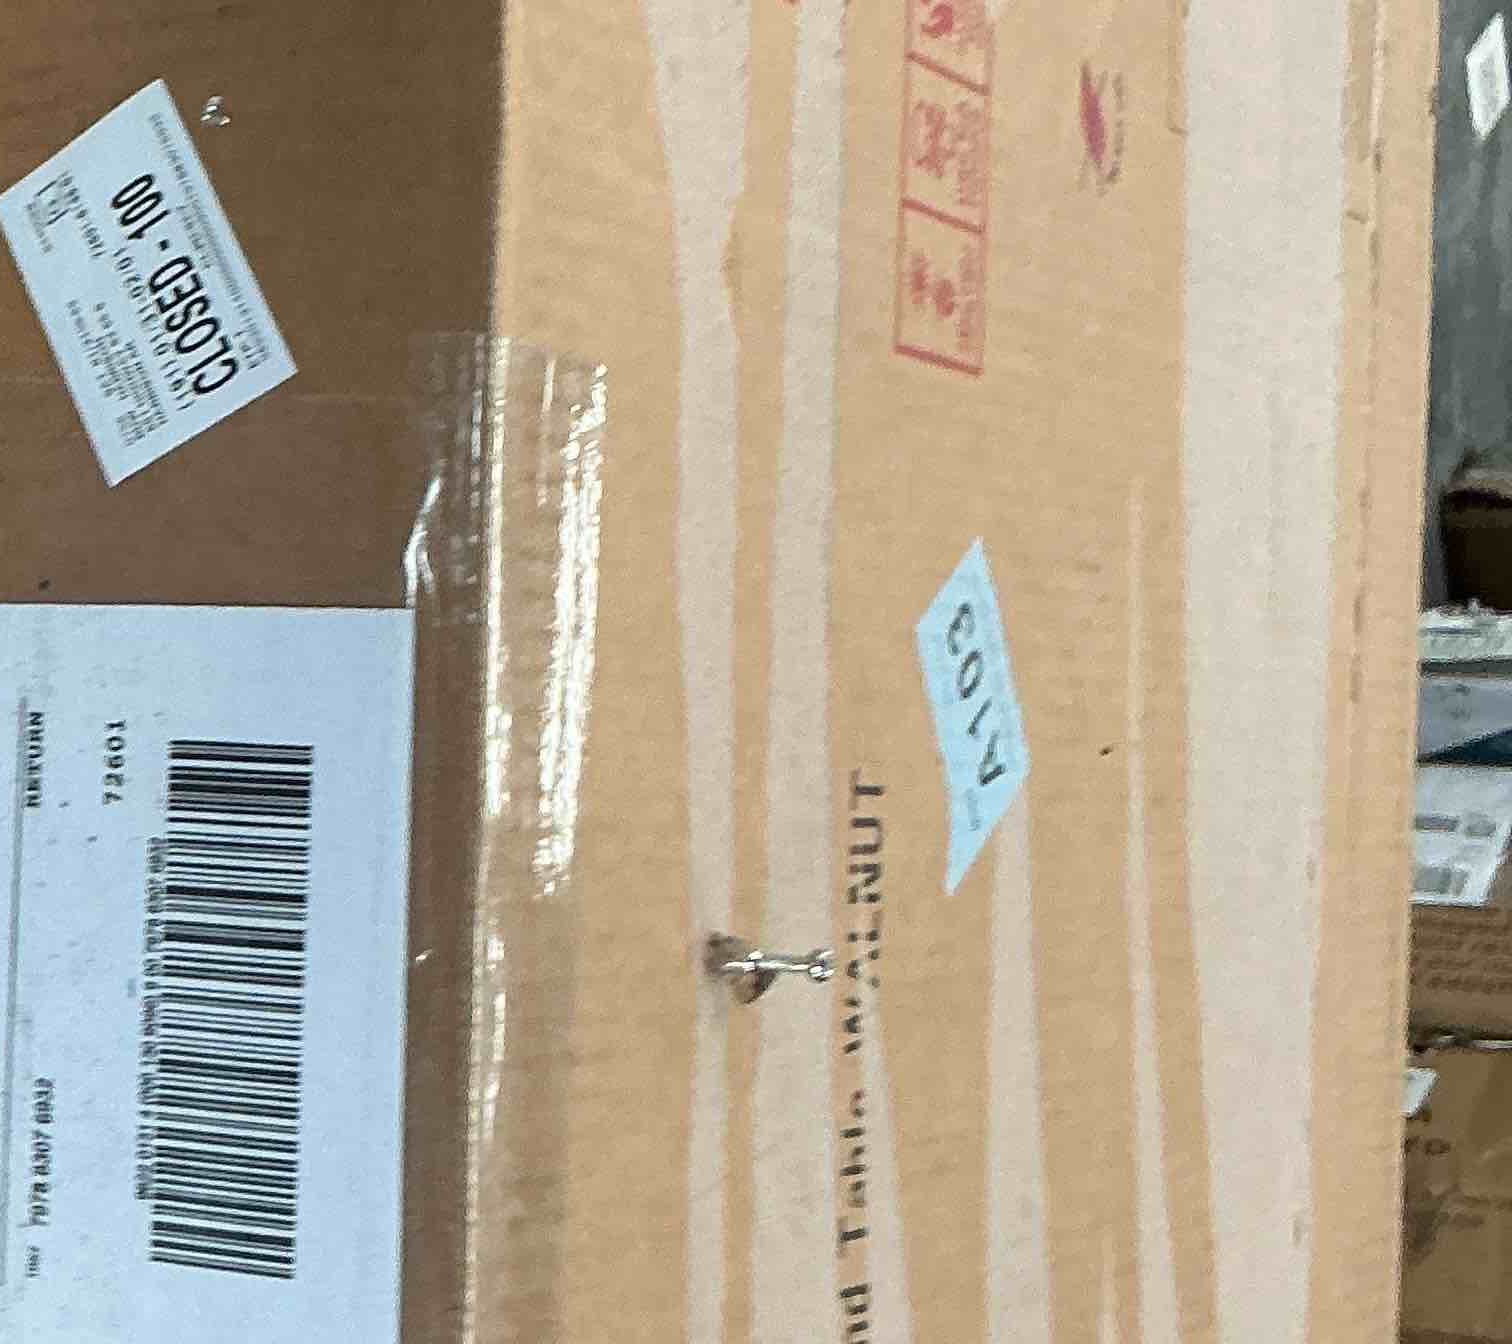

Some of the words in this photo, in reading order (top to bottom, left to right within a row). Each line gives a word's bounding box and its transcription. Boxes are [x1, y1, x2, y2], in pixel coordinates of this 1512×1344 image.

[110, 174, 173, 241] 100
[148, 255, 239, 395] CLOSED
[103, 718, 128, 806] 72601
